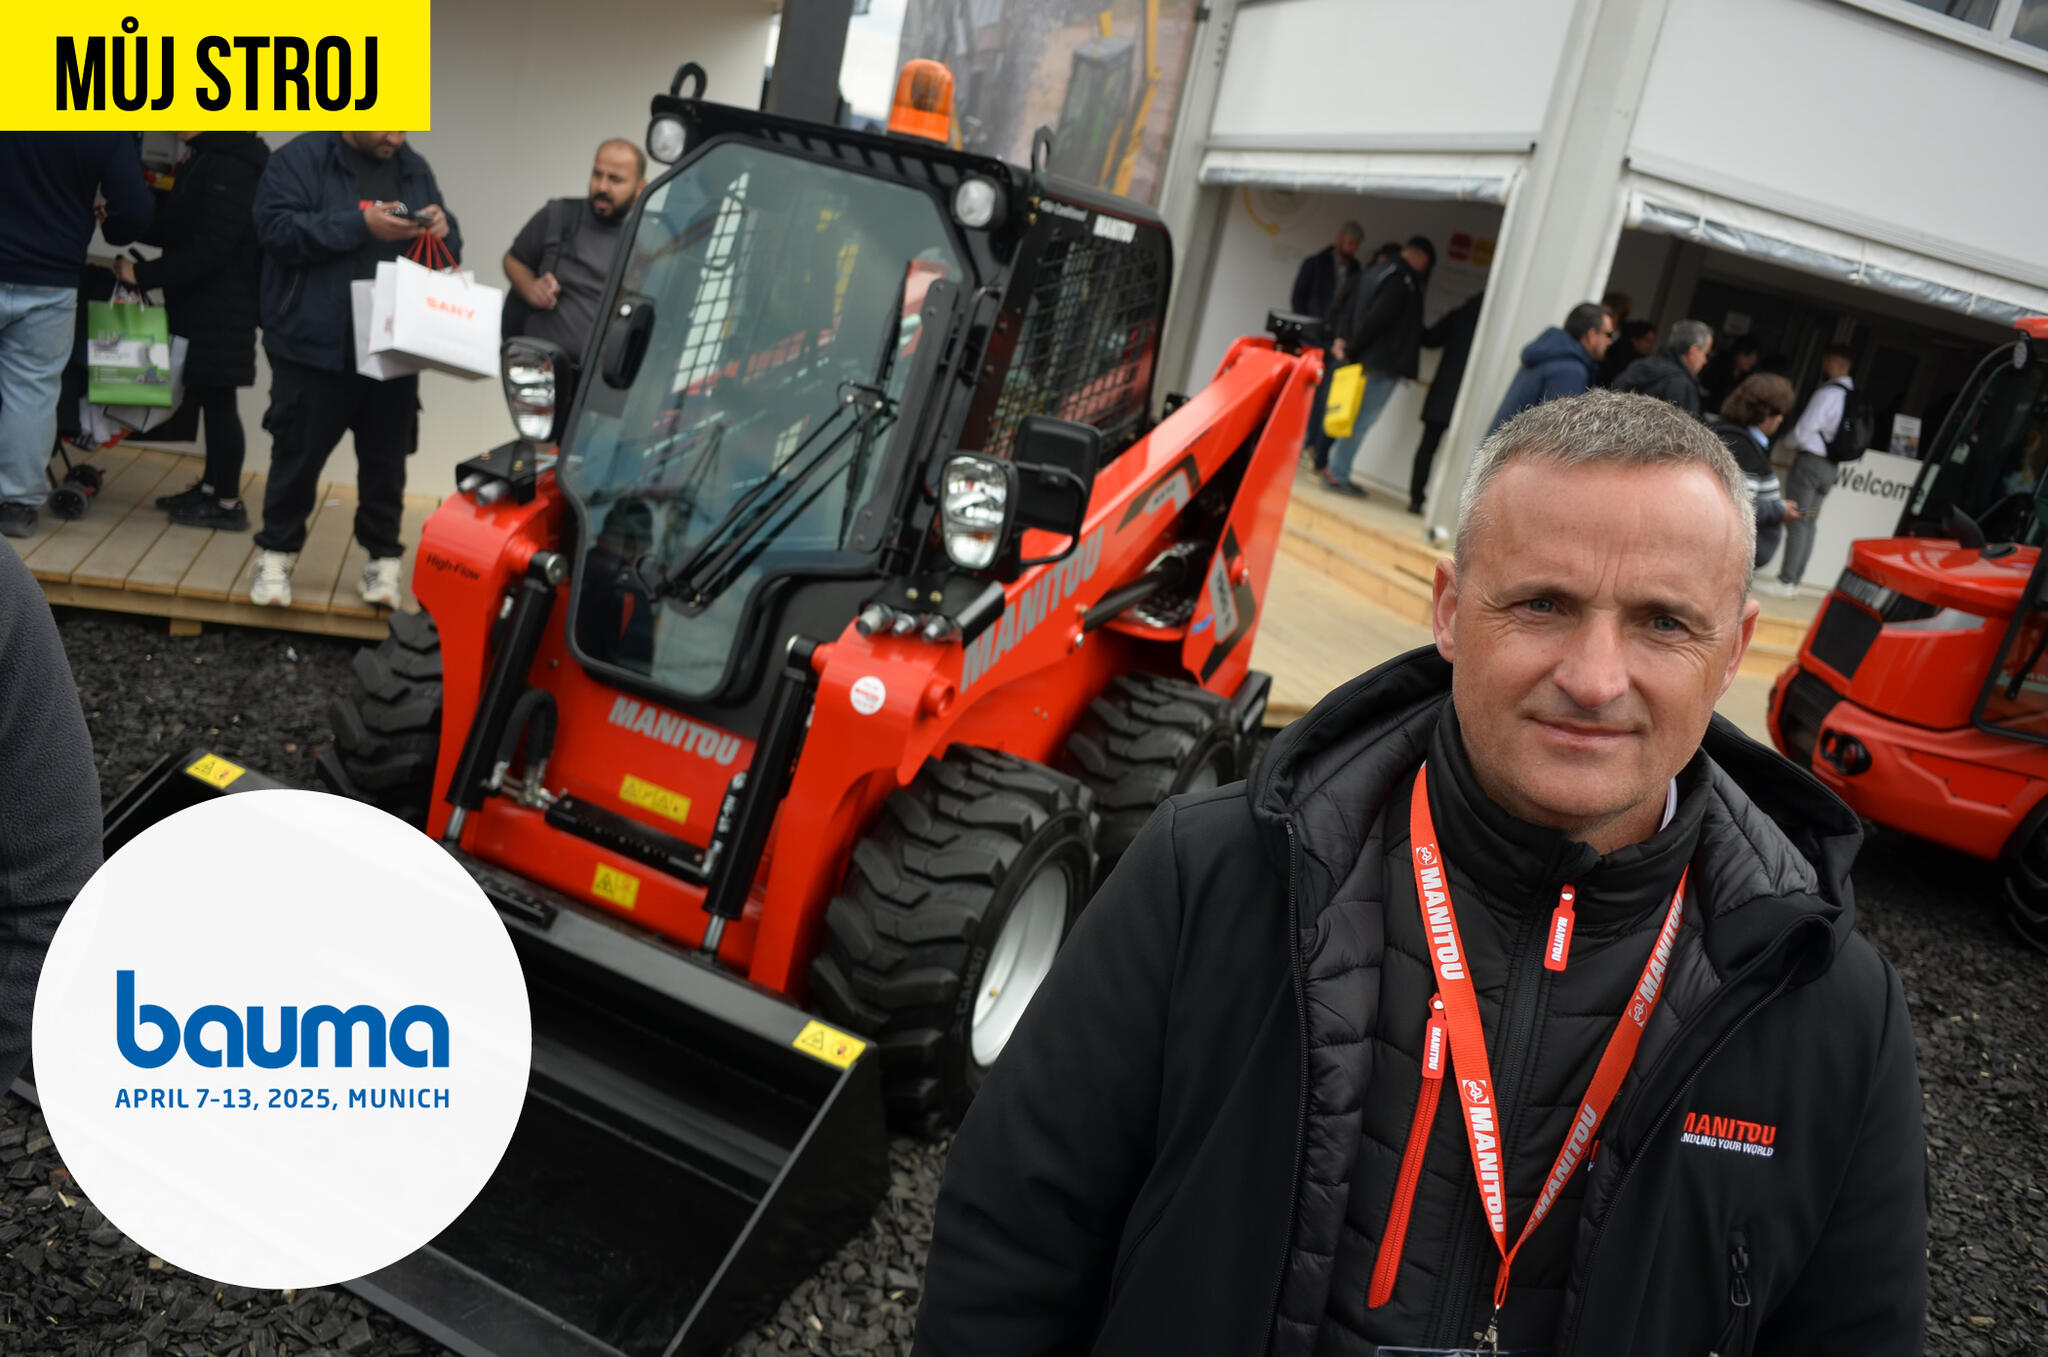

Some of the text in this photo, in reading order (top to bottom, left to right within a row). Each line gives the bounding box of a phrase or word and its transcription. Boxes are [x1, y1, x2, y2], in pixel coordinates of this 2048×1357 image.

[960, 524, 1104, 694] MANITOU
[608, 696, 742, 765] MANITOU
[1420, 866, 1465, 980] MANITOU
[1551, 916, 1568, 962] MANITOU
[1639, 891, 1683, 1004] MANITOU
[1428, 1026, 1441, 1070] MANITOU
[1469, 1107, 1504, 1232] MANITOU
[1535, 1104, 1597, 1220] MANITOU
[1718, 1139, 1741, 1152] YOUR
[1742, 1142, 1774, 1157] WORLD
